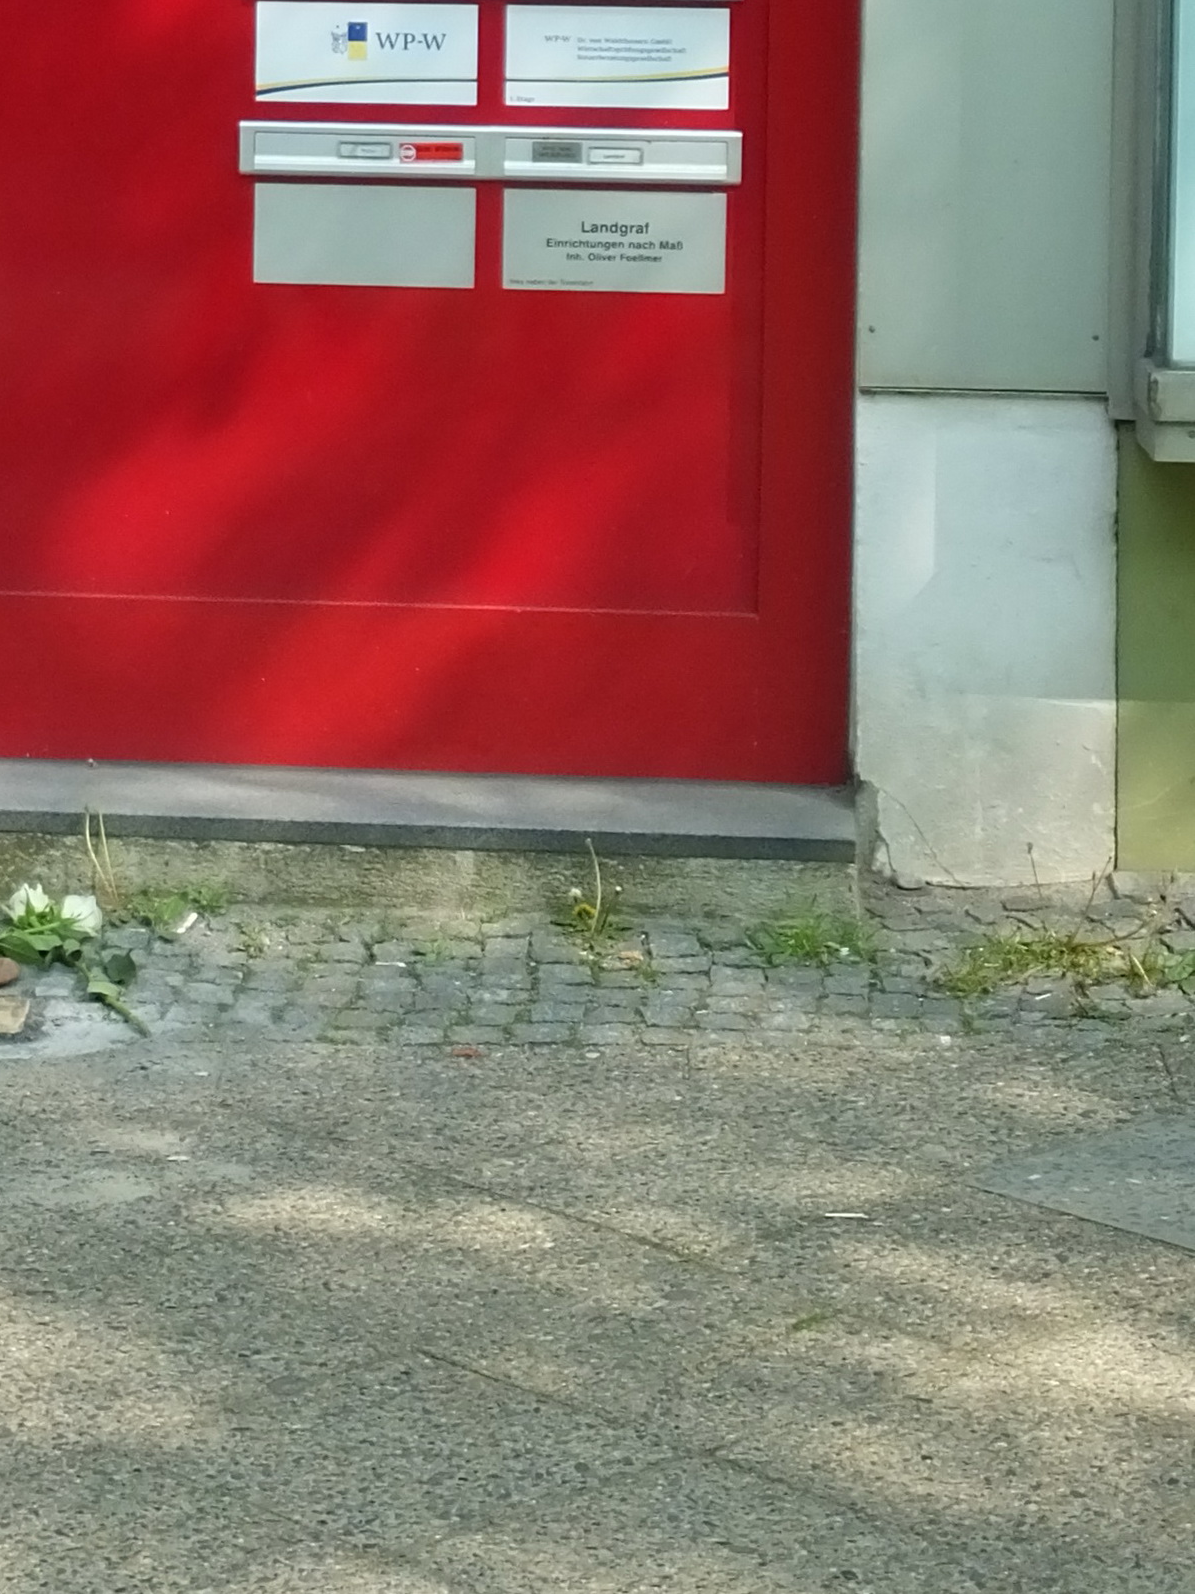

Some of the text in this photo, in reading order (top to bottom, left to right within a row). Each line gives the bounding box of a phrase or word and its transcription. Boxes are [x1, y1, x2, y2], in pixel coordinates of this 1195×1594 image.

[375, 32, 446, 51] WP-W
[581, 221, 650, 237] Landgraf
[546, 238, 683, 250] Einrichtungen nach Maß
[566, 253, 584, 261] Inh.
[588, 253, 617, 262] Oliver
